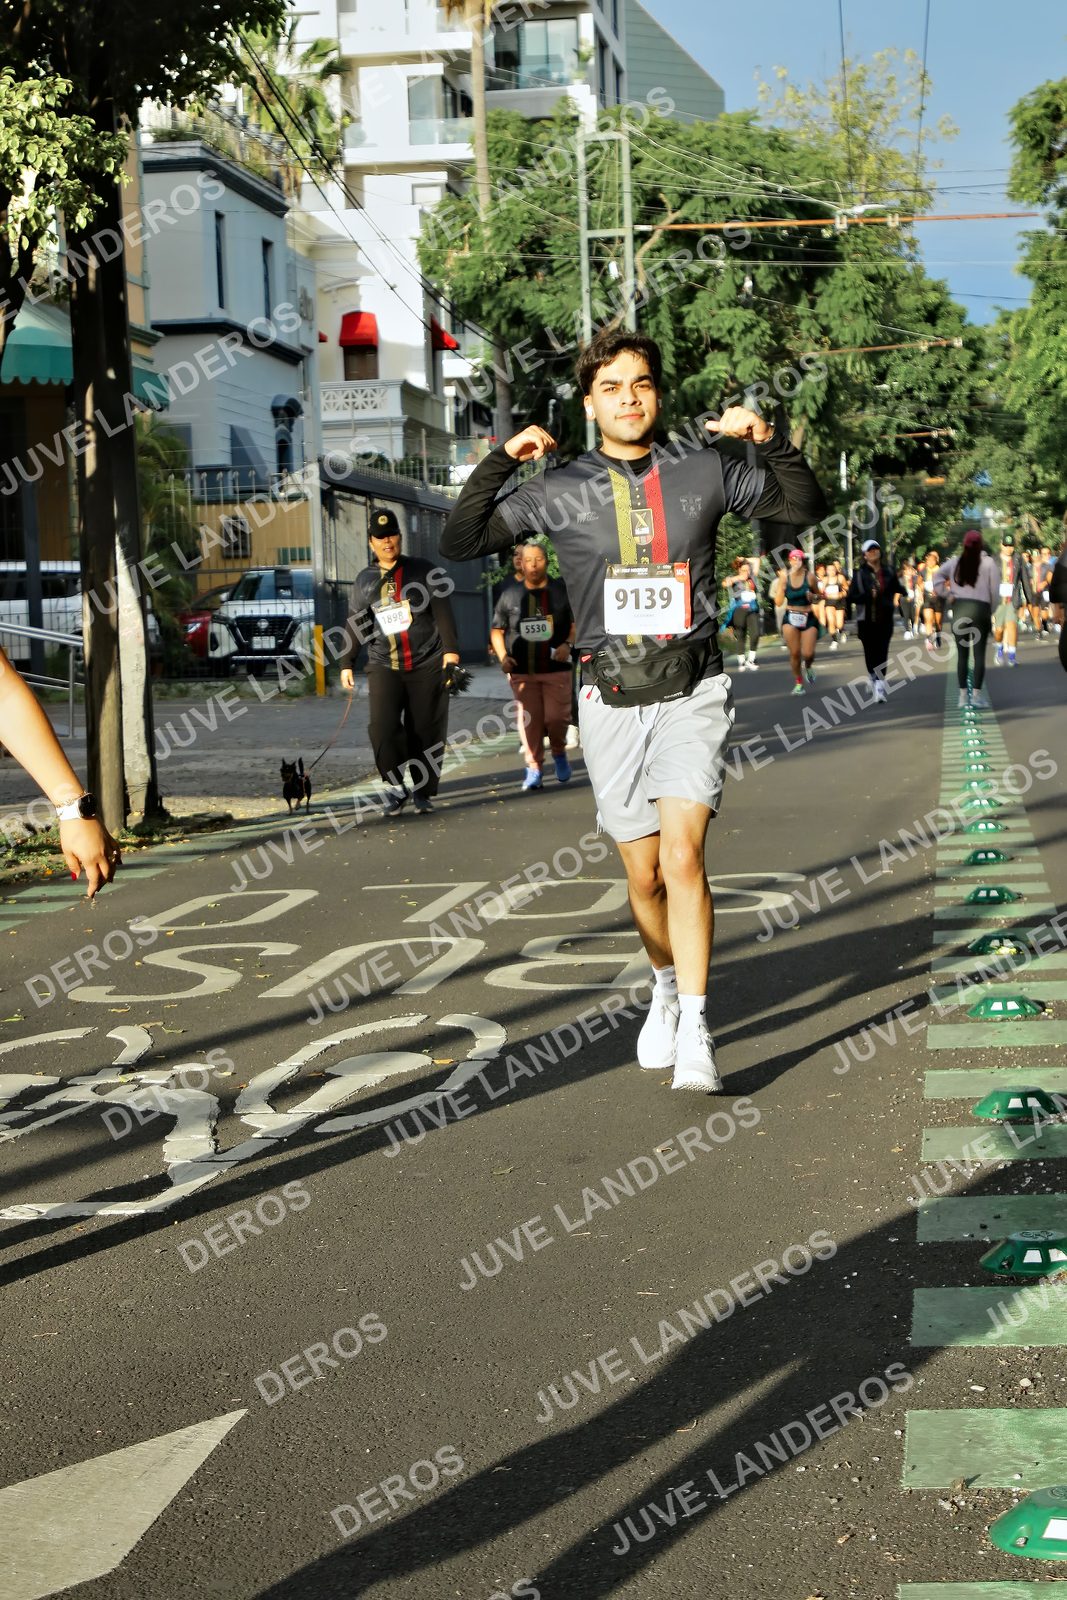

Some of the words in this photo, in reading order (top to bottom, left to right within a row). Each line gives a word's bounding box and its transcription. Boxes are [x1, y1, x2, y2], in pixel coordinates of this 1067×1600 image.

[614, 586, 673, 610] 9139
[525, 623, 547, 634] 5530
[68, 937, 663, 1002] BUS
